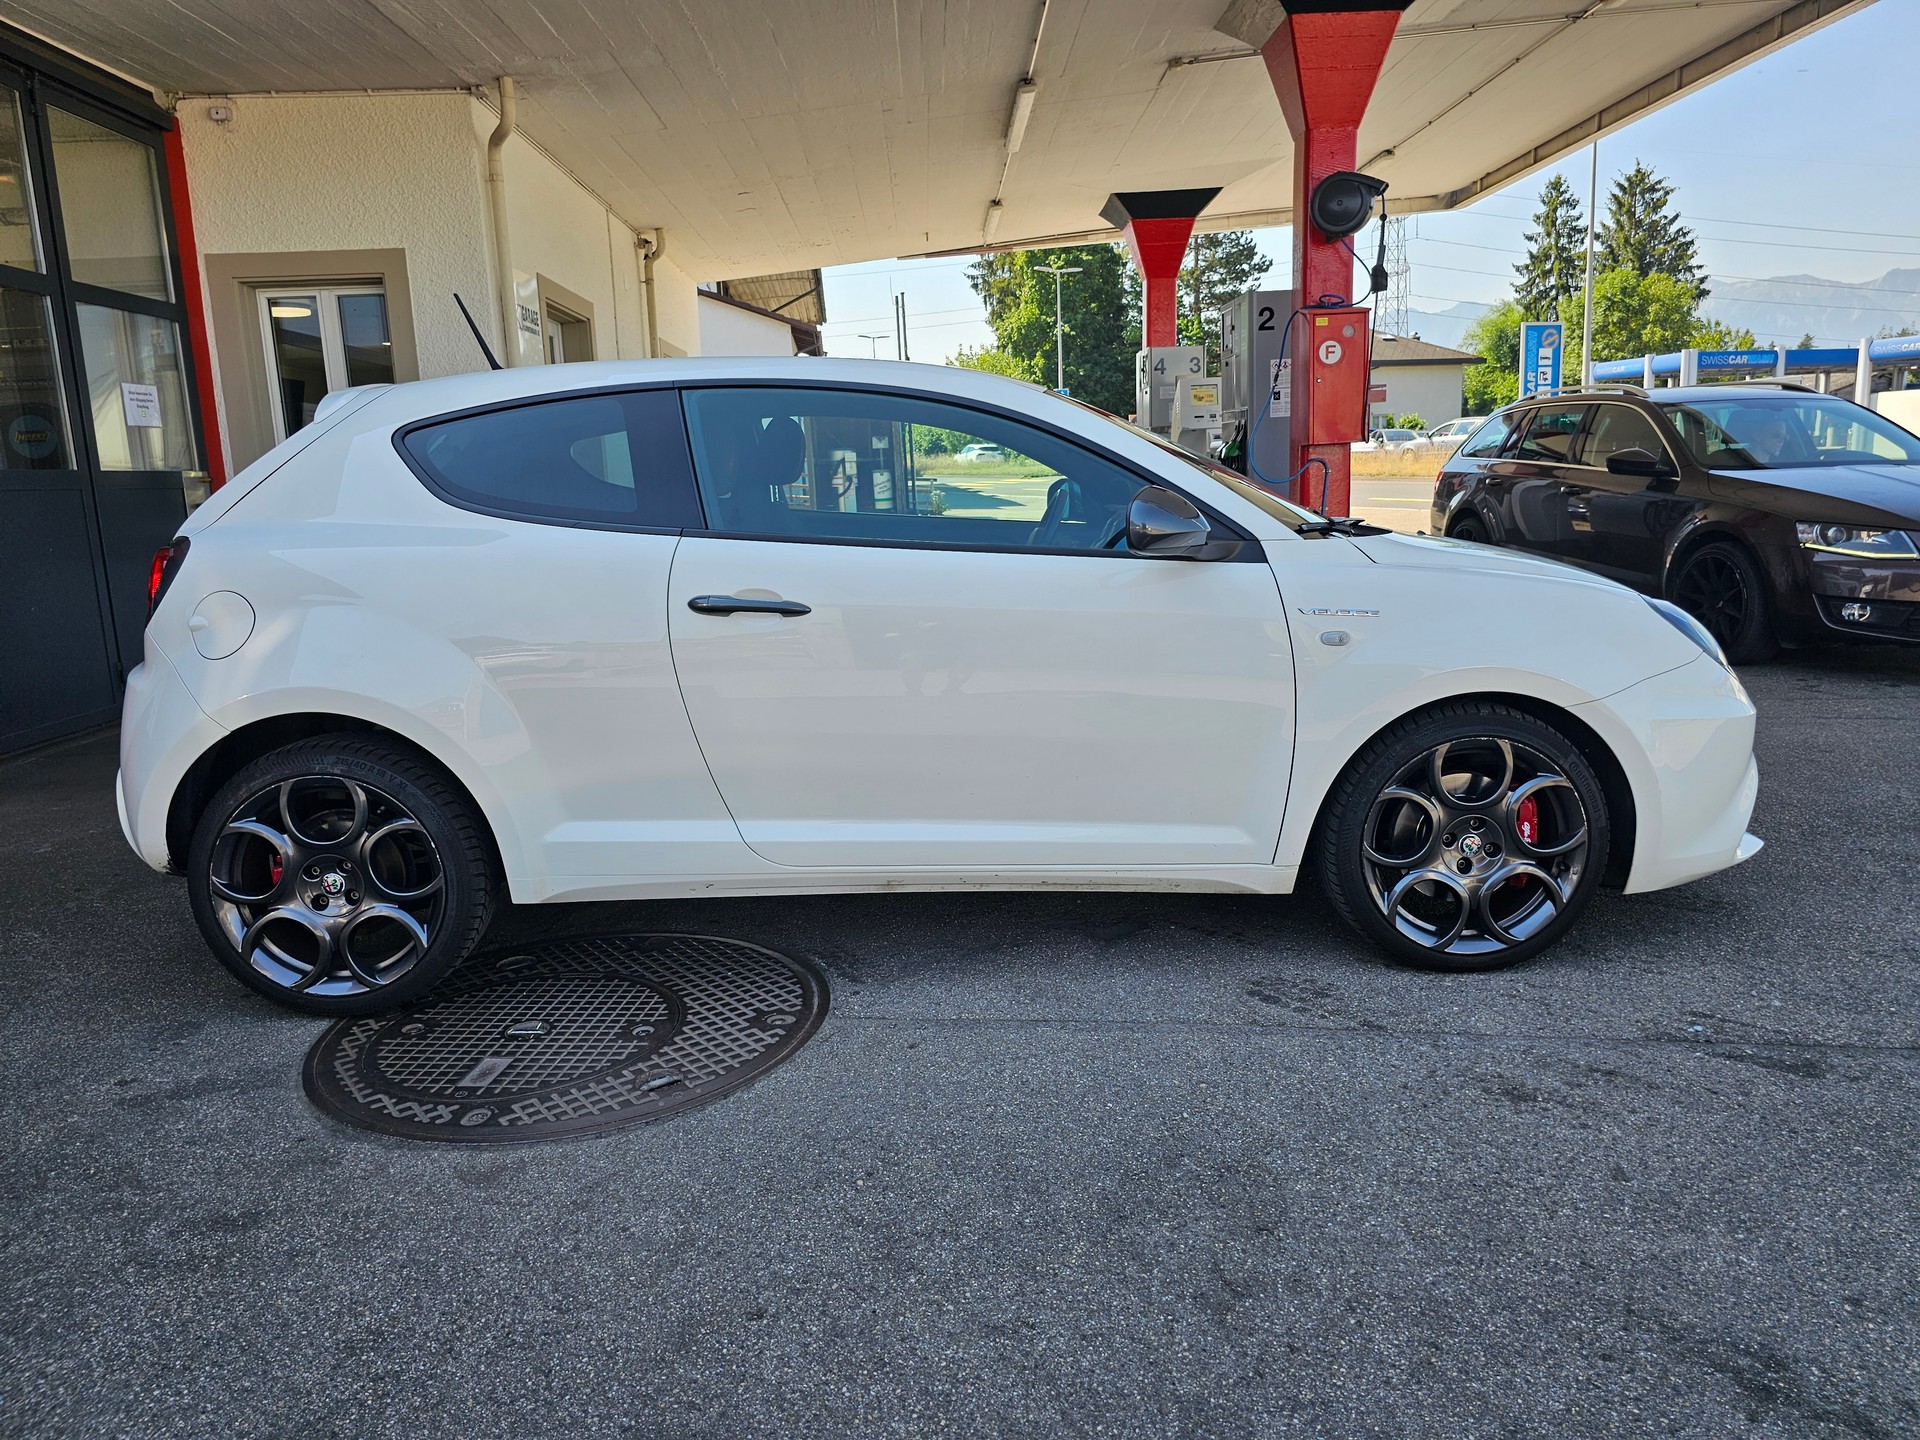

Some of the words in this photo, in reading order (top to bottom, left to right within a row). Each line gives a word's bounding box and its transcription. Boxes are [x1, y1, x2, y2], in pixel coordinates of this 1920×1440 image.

[521, 305, 539, 327] GARAGE
[1258, 306, 1275, 331] 2
[1325, 345, 1336, 360] F
[1154, 357, 1167, 375] 4
[1189, 356, 1202, 374] 3
[1297, 607, 1380, 617] VELOCE
